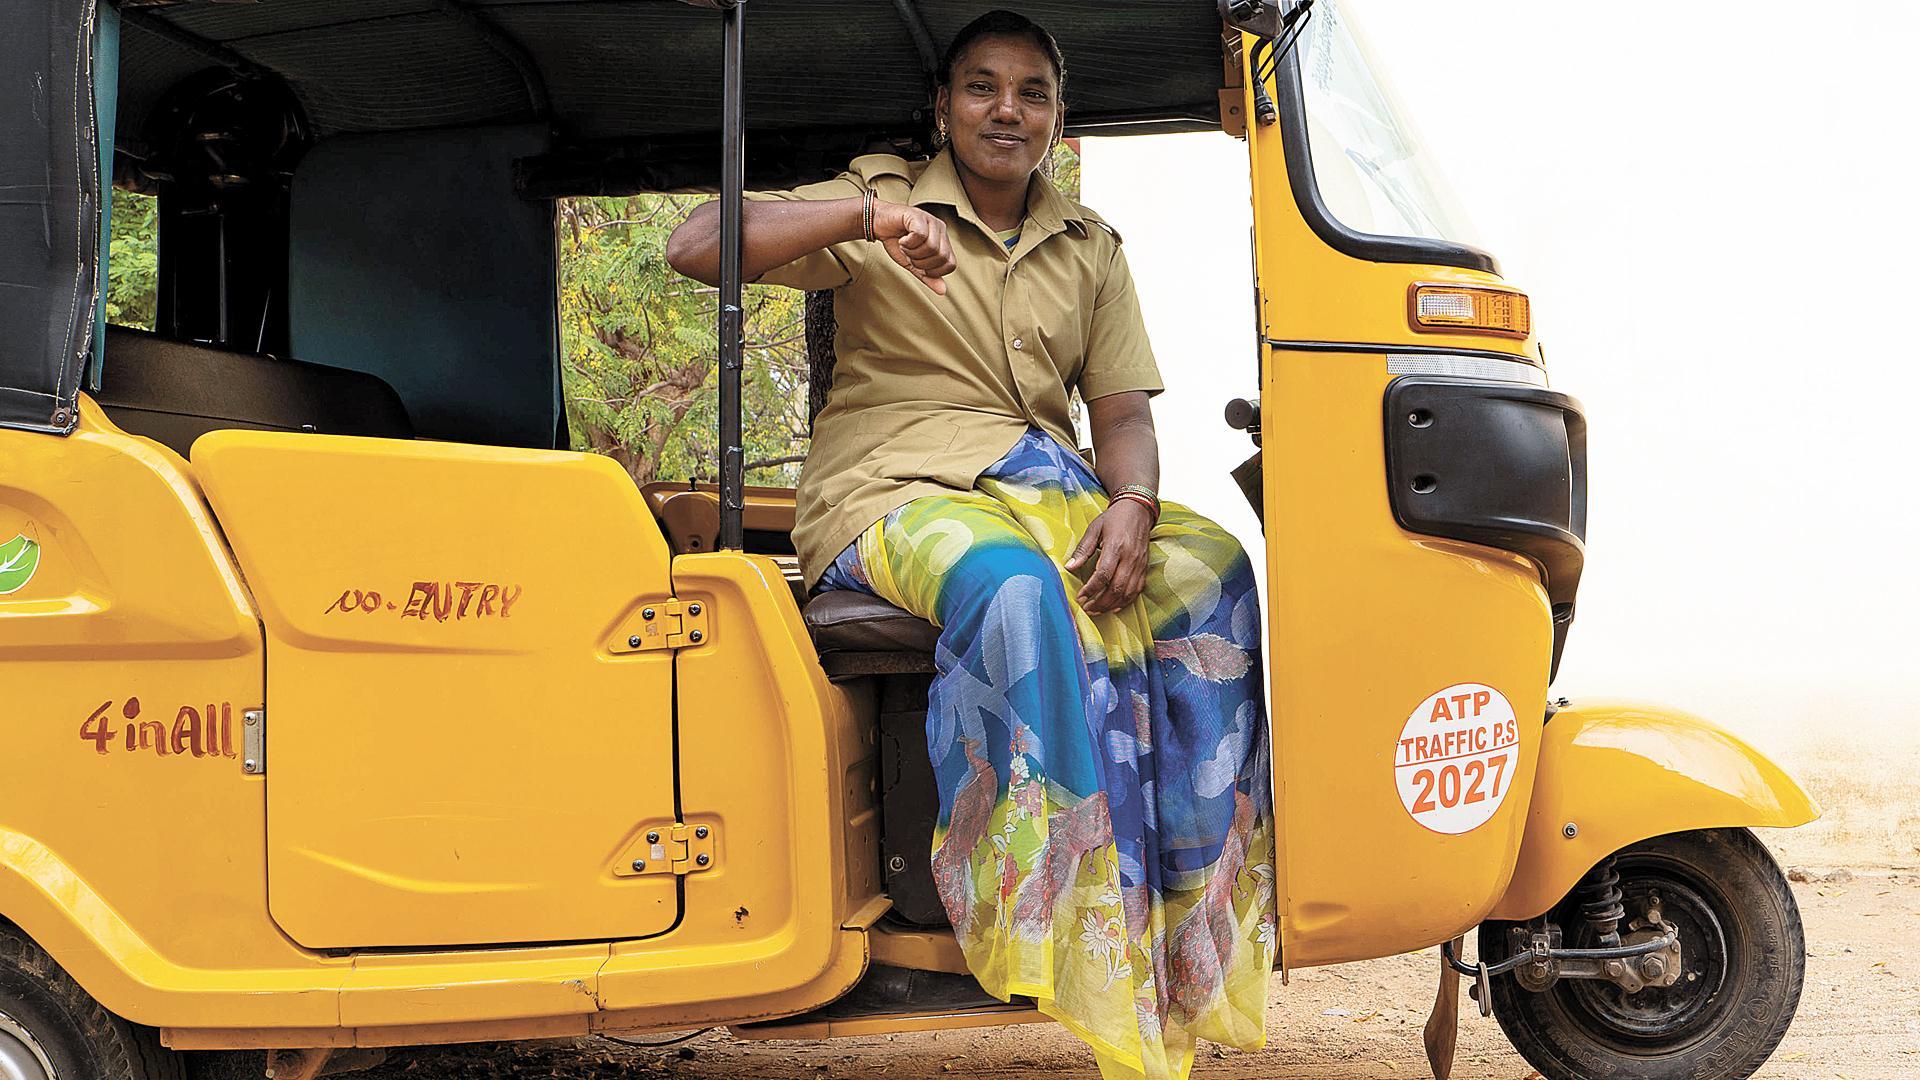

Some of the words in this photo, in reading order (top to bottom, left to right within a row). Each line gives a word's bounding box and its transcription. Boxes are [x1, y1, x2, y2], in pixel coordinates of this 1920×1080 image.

[401, 581, 523, 623] ENTRY
[1430, 691, 1490, 722] ATP
[1401, 726, 1487, 762] TRAFFIC
[1493, 719, 1515, 747] P.S
[1412, 754, 1508, 814] 2027
